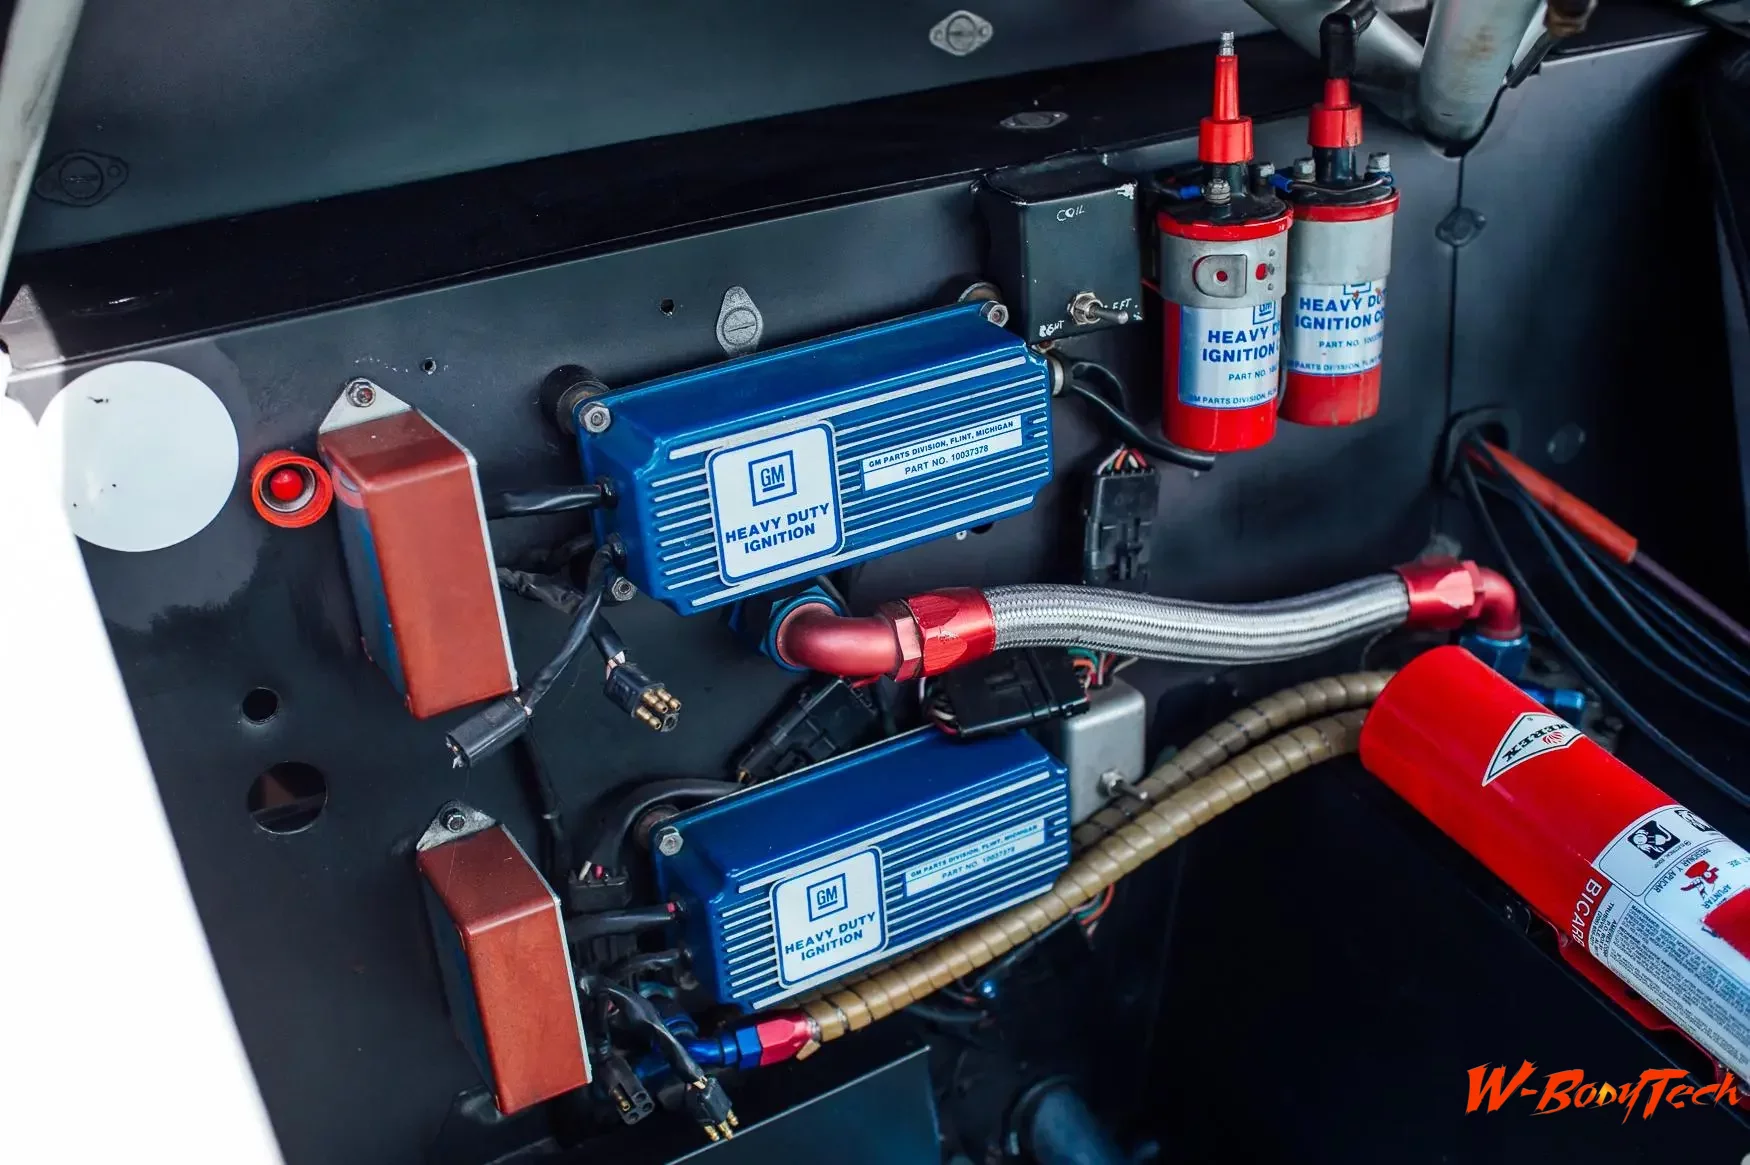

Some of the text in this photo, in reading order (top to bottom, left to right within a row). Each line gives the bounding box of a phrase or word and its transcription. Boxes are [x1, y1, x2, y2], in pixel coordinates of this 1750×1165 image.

[1056, 204, 1085, 221] COIL
[1104, 298, 1132, 311] EFT
[1300, 296, 1362, 312] HEAVY
[1294, 313, 1372, 330] IGNITION
[1207, 326, 1269, 344] HEAVY
[1318, 340, 1343, 349] PART
[1202, 341, 1275, 363] IGNITION
[1228, 372, 1252, 382] PART
[1203, 396, 1230, 405] PARTS
[869, 420, 1014, 468] GM PARTS DIVISION, FLINT, MICHIGAN
[905, 444, 989, 475] PART NO. 10037378
[760, 464, 785, 488] GM
[725, 502, 830, 544] HEAVY DUTY
[744, 522, 816, 554] IGNITION
[923, 859, 947, 873] PARTS
[942, 865, 963, 879] PART
[1653, 870, 1677, 893] APLICAR
[816, 885, 838, 906] GM
[1701, 883, 1732, 909] APUNTAR
[784, 911, 876, 955] HEAVY DUTY
[801, 929, 864, 961] IGNITION
